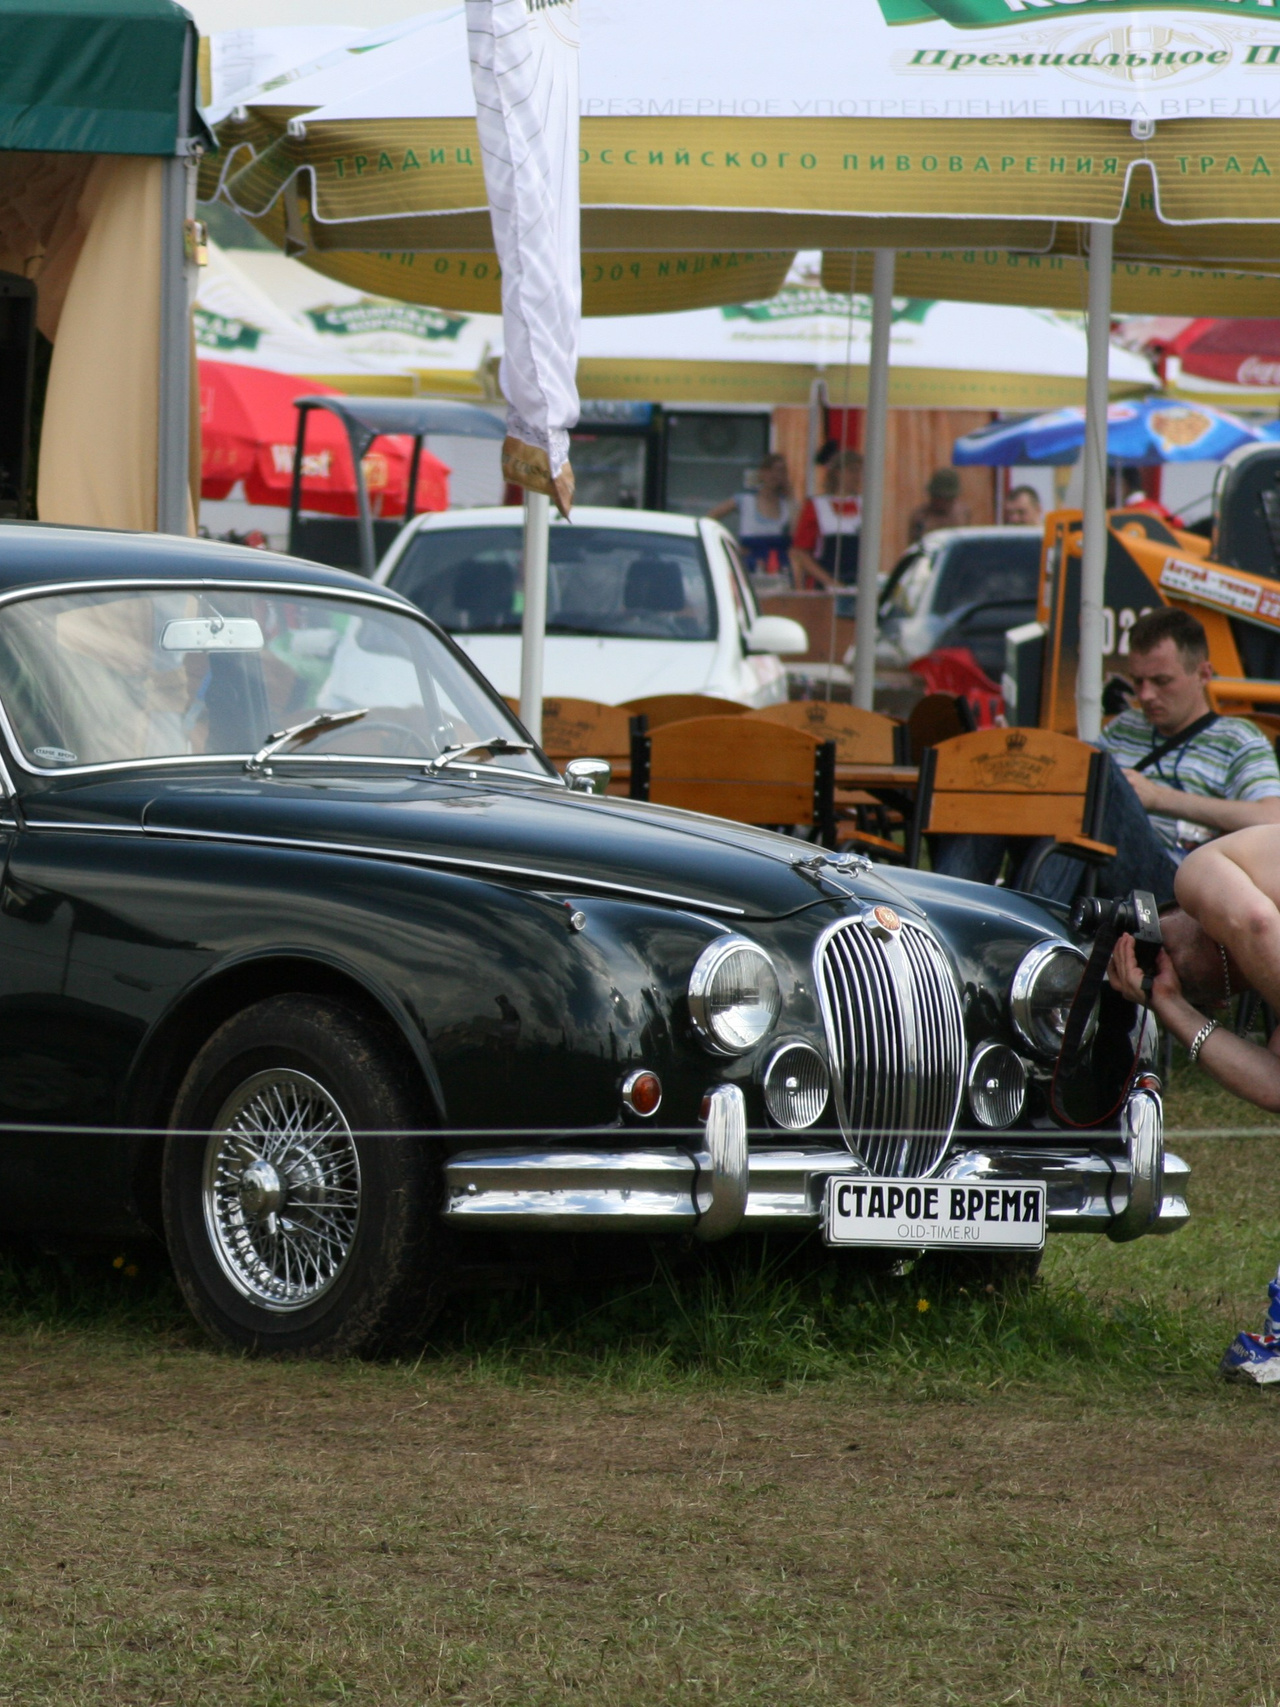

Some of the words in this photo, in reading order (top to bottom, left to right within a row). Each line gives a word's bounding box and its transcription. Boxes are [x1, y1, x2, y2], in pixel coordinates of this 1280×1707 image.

[906, 48, 1229, 71] Премиальное
[579, 98, 781, 116] РЕЗМЕРНОЕ
[792, 99, 1049, 116] УПОТРЕБЛЕНИЕ
[1061, 99, 1149, 116] ПИВА
[1161, 98, 1280, 116] ВРЕДИ
[333, 147, 473, 178] ТРАДИЦ
[578, 148, 818, 170] ОССИЙСКОГО
[842, 153, 1118, 174] ПИВОВАРЕНИЯ
[1176, 155, 1271, 176] ТРАД
[837, 1184, 939, 1220] СТАРОЕ
[949, 1188, 1041, 1223] ВРЕМЯ
[897, 1223, 981, 1240] OLD-TIME.RU
